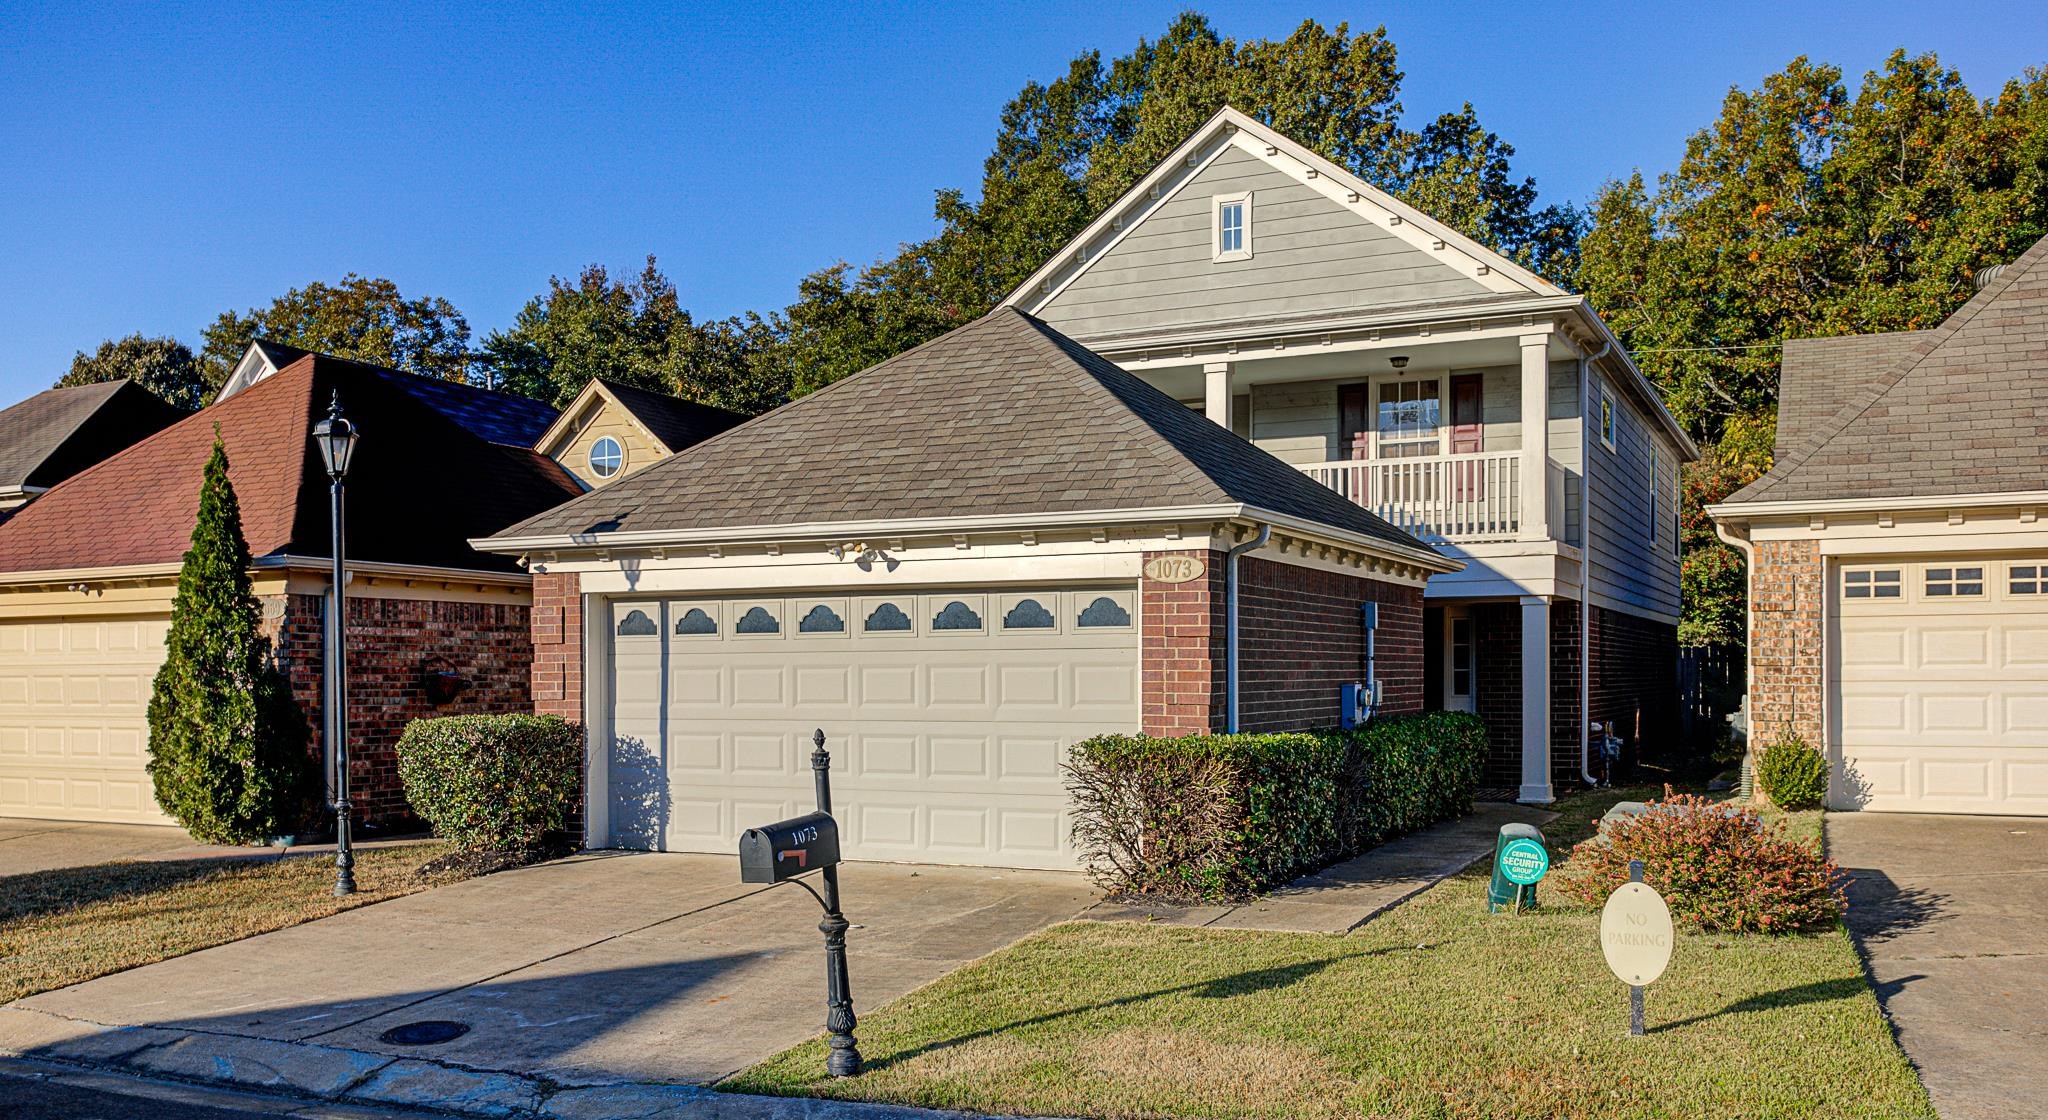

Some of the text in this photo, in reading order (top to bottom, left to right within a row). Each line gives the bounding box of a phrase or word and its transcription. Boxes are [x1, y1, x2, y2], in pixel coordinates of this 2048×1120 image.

[1156, 559, 1192, 578] 1073
[792, 826, 818, 846] 1073
[1511, 850, 1539, 861] CENTRAL
[1502, 856, 1546, 870] SECURITY
[1512, 866, 1533, 875] GROUP
[1625, 912, 1648, 926] NO
[1608, 932, 1665, 947] PARKING
